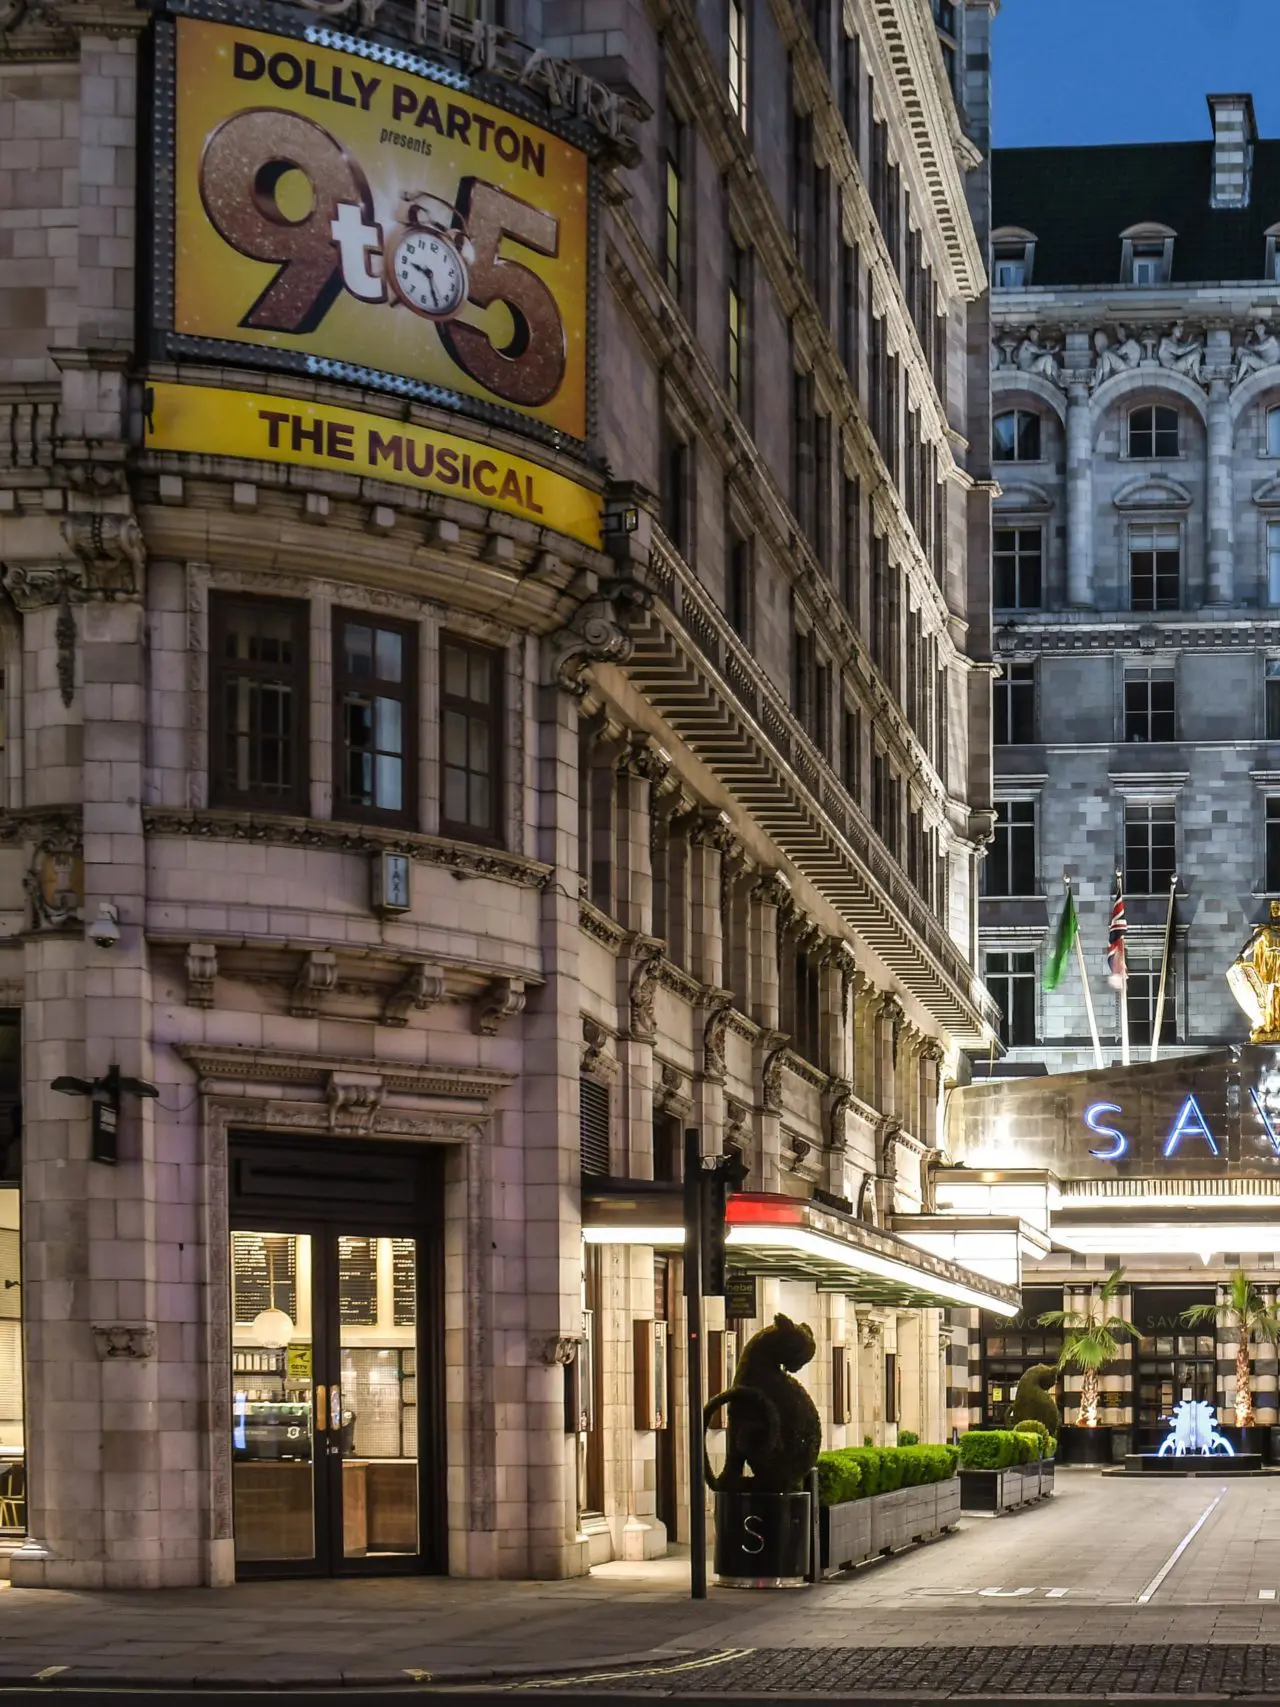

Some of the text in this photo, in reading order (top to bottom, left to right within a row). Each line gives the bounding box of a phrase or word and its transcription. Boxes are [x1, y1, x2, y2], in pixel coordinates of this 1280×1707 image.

[232, 42, 546, 178] DOLLY PARTON
[379, 127, 433, 157] presents
[198, 106, 373, 335] 9
[436, 175, 566, 407] 5
[259, 409, 544, 514] THE MUSICAL
[392, 858, 400, 904] TAXI
[994, 1315, 1050, 1330] SAVO
[741, 1515, 764, 1554] S
